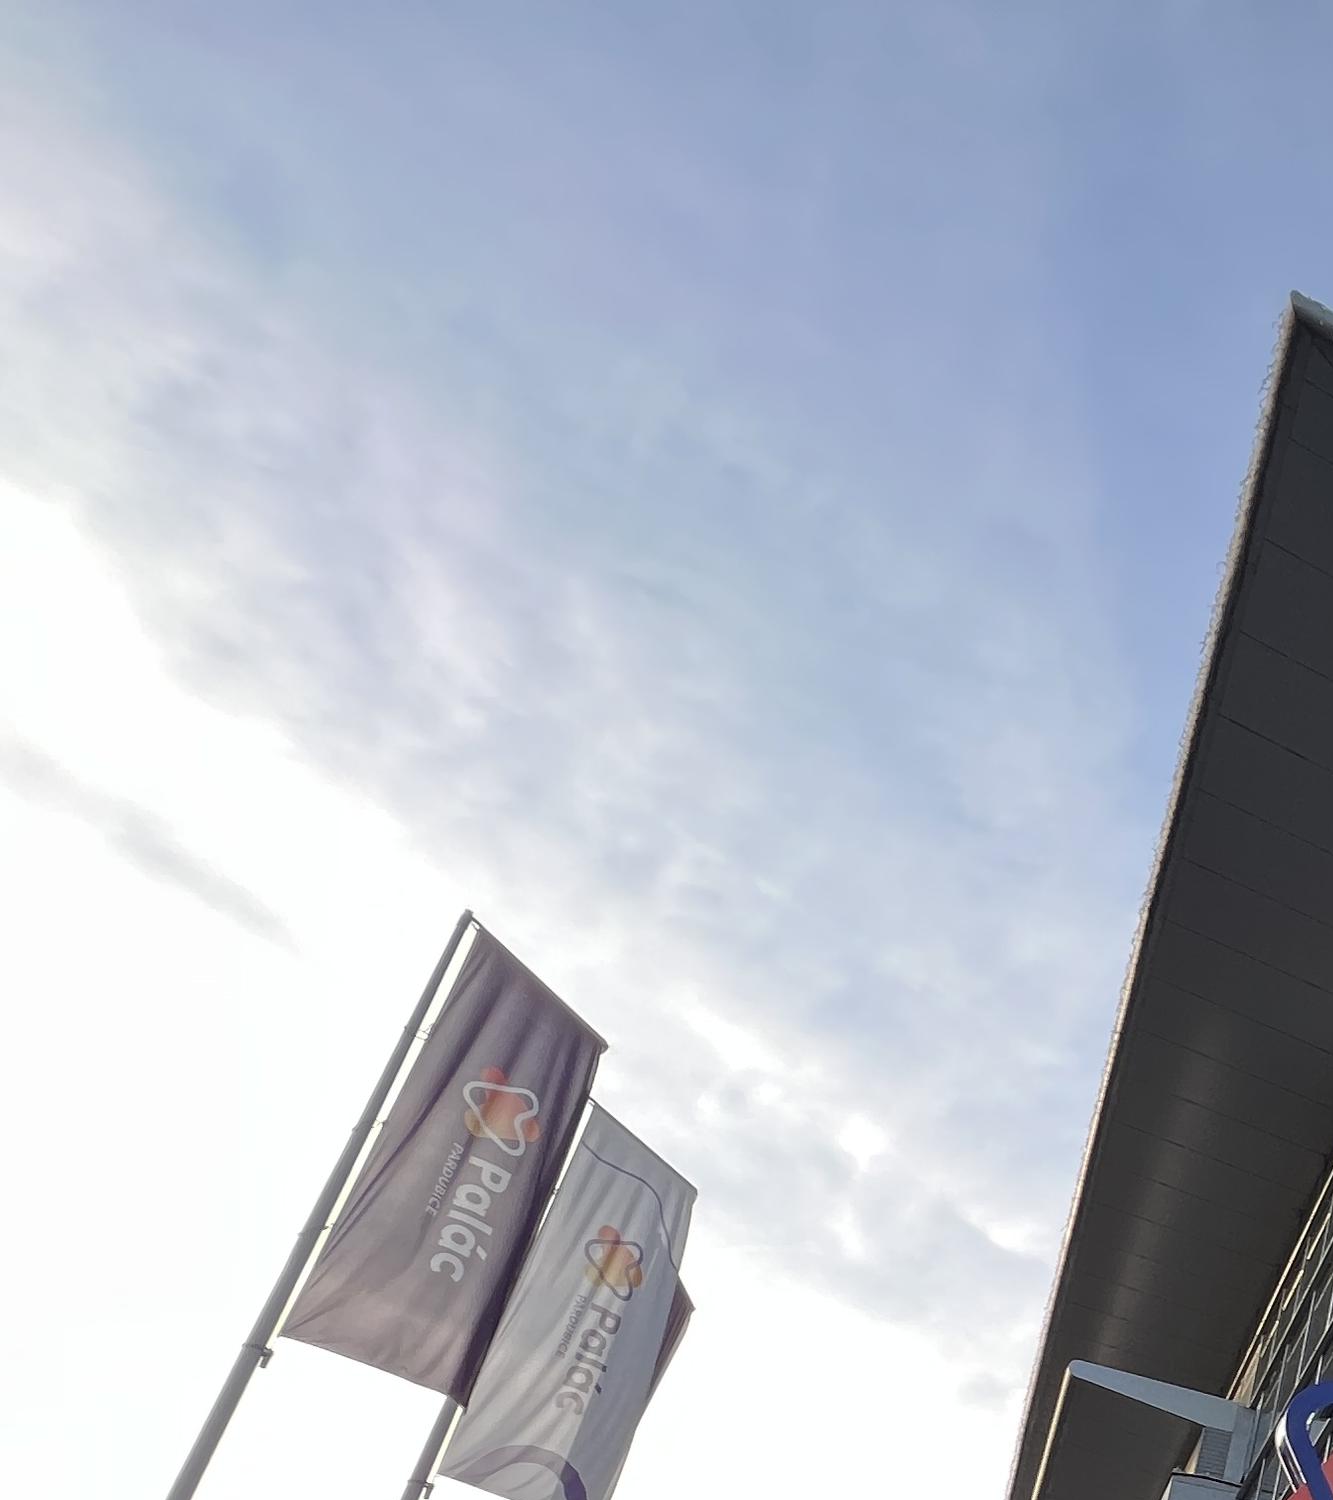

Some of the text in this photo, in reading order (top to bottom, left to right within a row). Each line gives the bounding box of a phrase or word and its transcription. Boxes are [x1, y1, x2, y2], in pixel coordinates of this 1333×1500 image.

[425, 1143, 464, 1216] PARDUBICE
[430, 1156, 512, 1283] Palác
[555, 1302, 621, 1416] Palác
